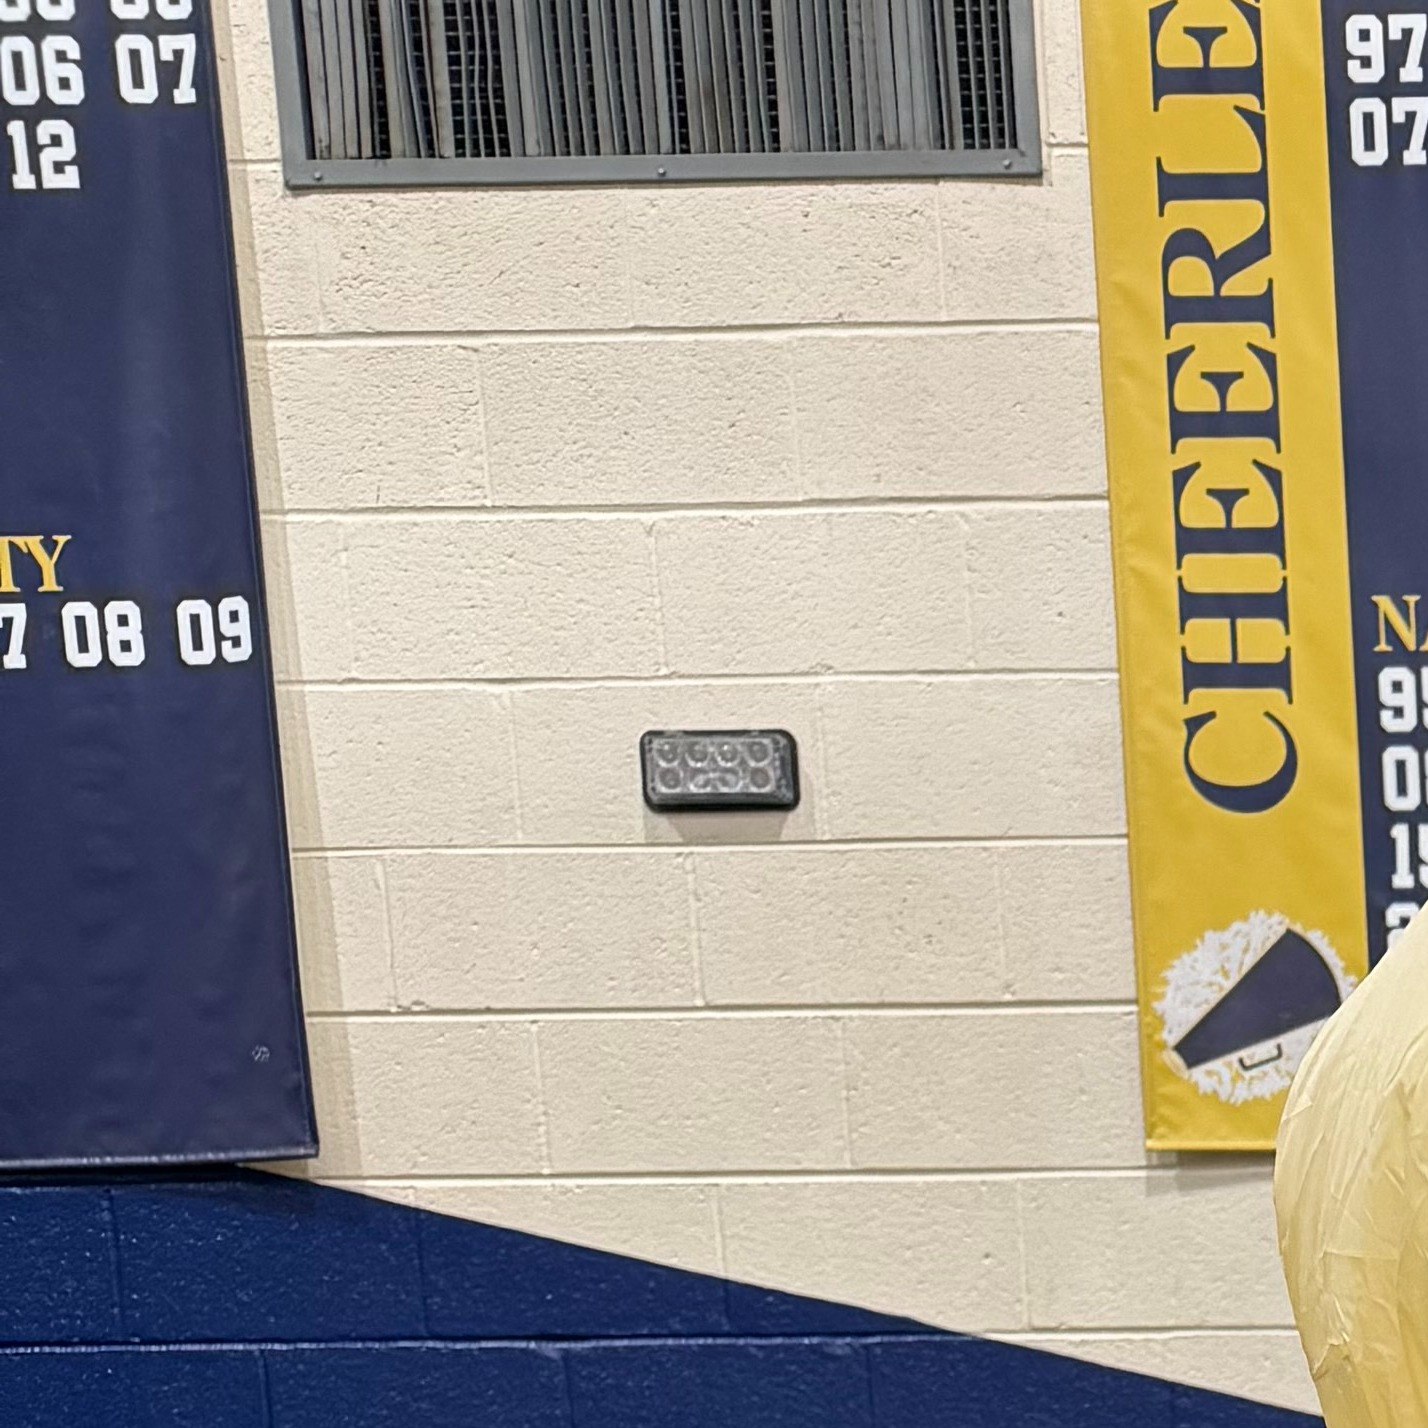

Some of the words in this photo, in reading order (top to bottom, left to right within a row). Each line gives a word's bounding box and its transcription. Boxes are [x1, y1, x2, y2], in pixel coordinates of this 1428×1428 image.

[0, 35, 85, 105] 06
[115, 33, 196, 104] 07
[1345, 14, 1427, 83] 97
[7, 120, 80, 189] 12
[61, 601, 146, 668] 08
[176, 596, 253, 665] 09
